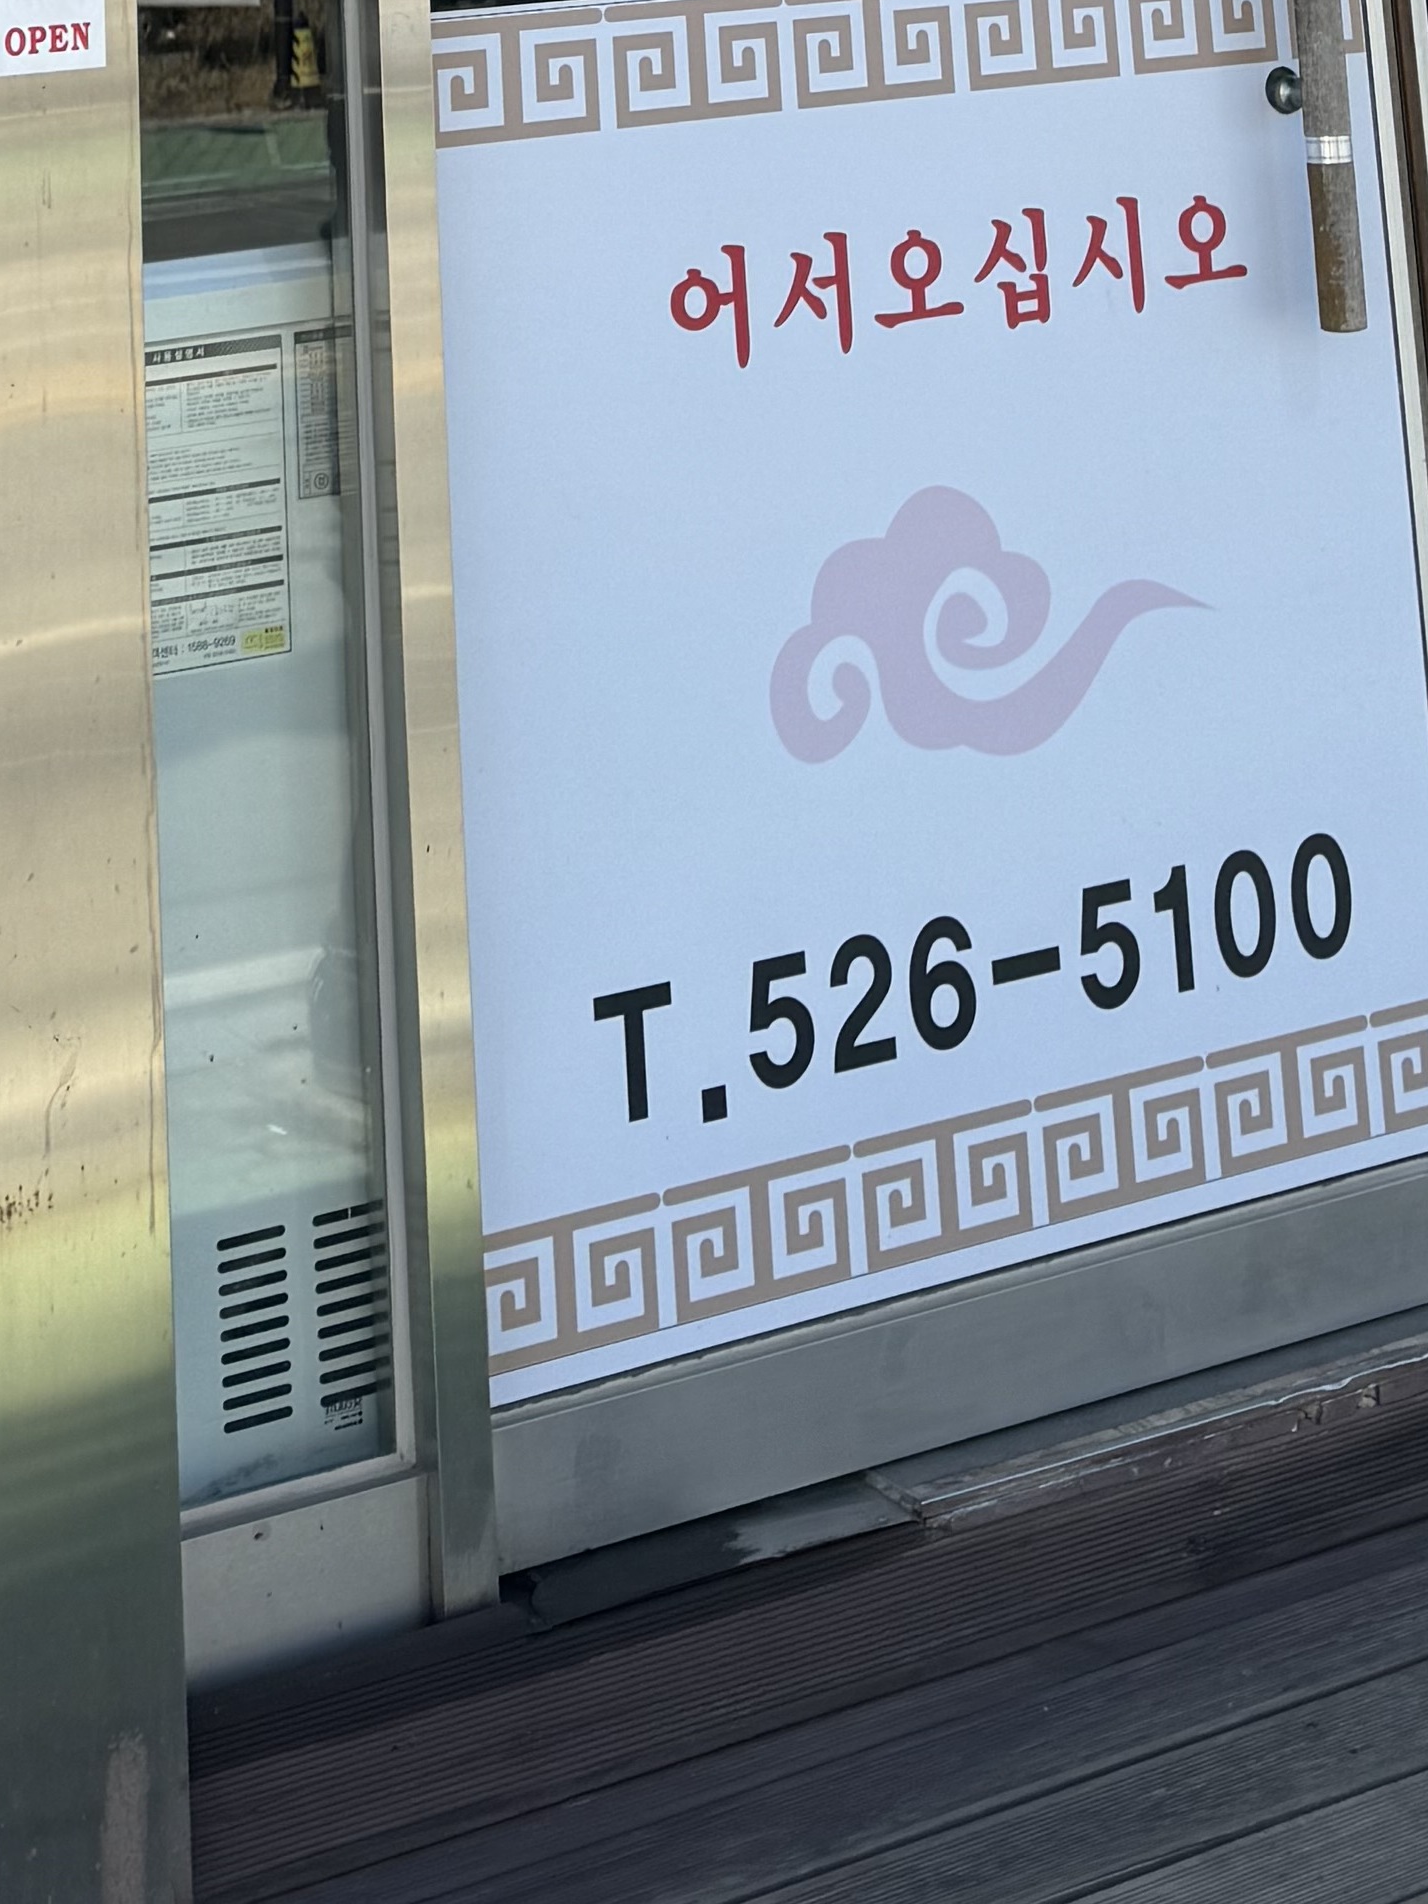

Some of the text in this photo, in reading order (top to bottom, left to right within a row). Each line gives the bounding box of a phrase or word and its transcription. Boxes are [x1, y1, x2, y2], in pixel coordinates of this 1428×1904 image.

[5, 22, 91, 56] OPEN
[670, 195, 1249, 369] 어서오십시오
[593, 832, 1353, 1124] T.526-5100
